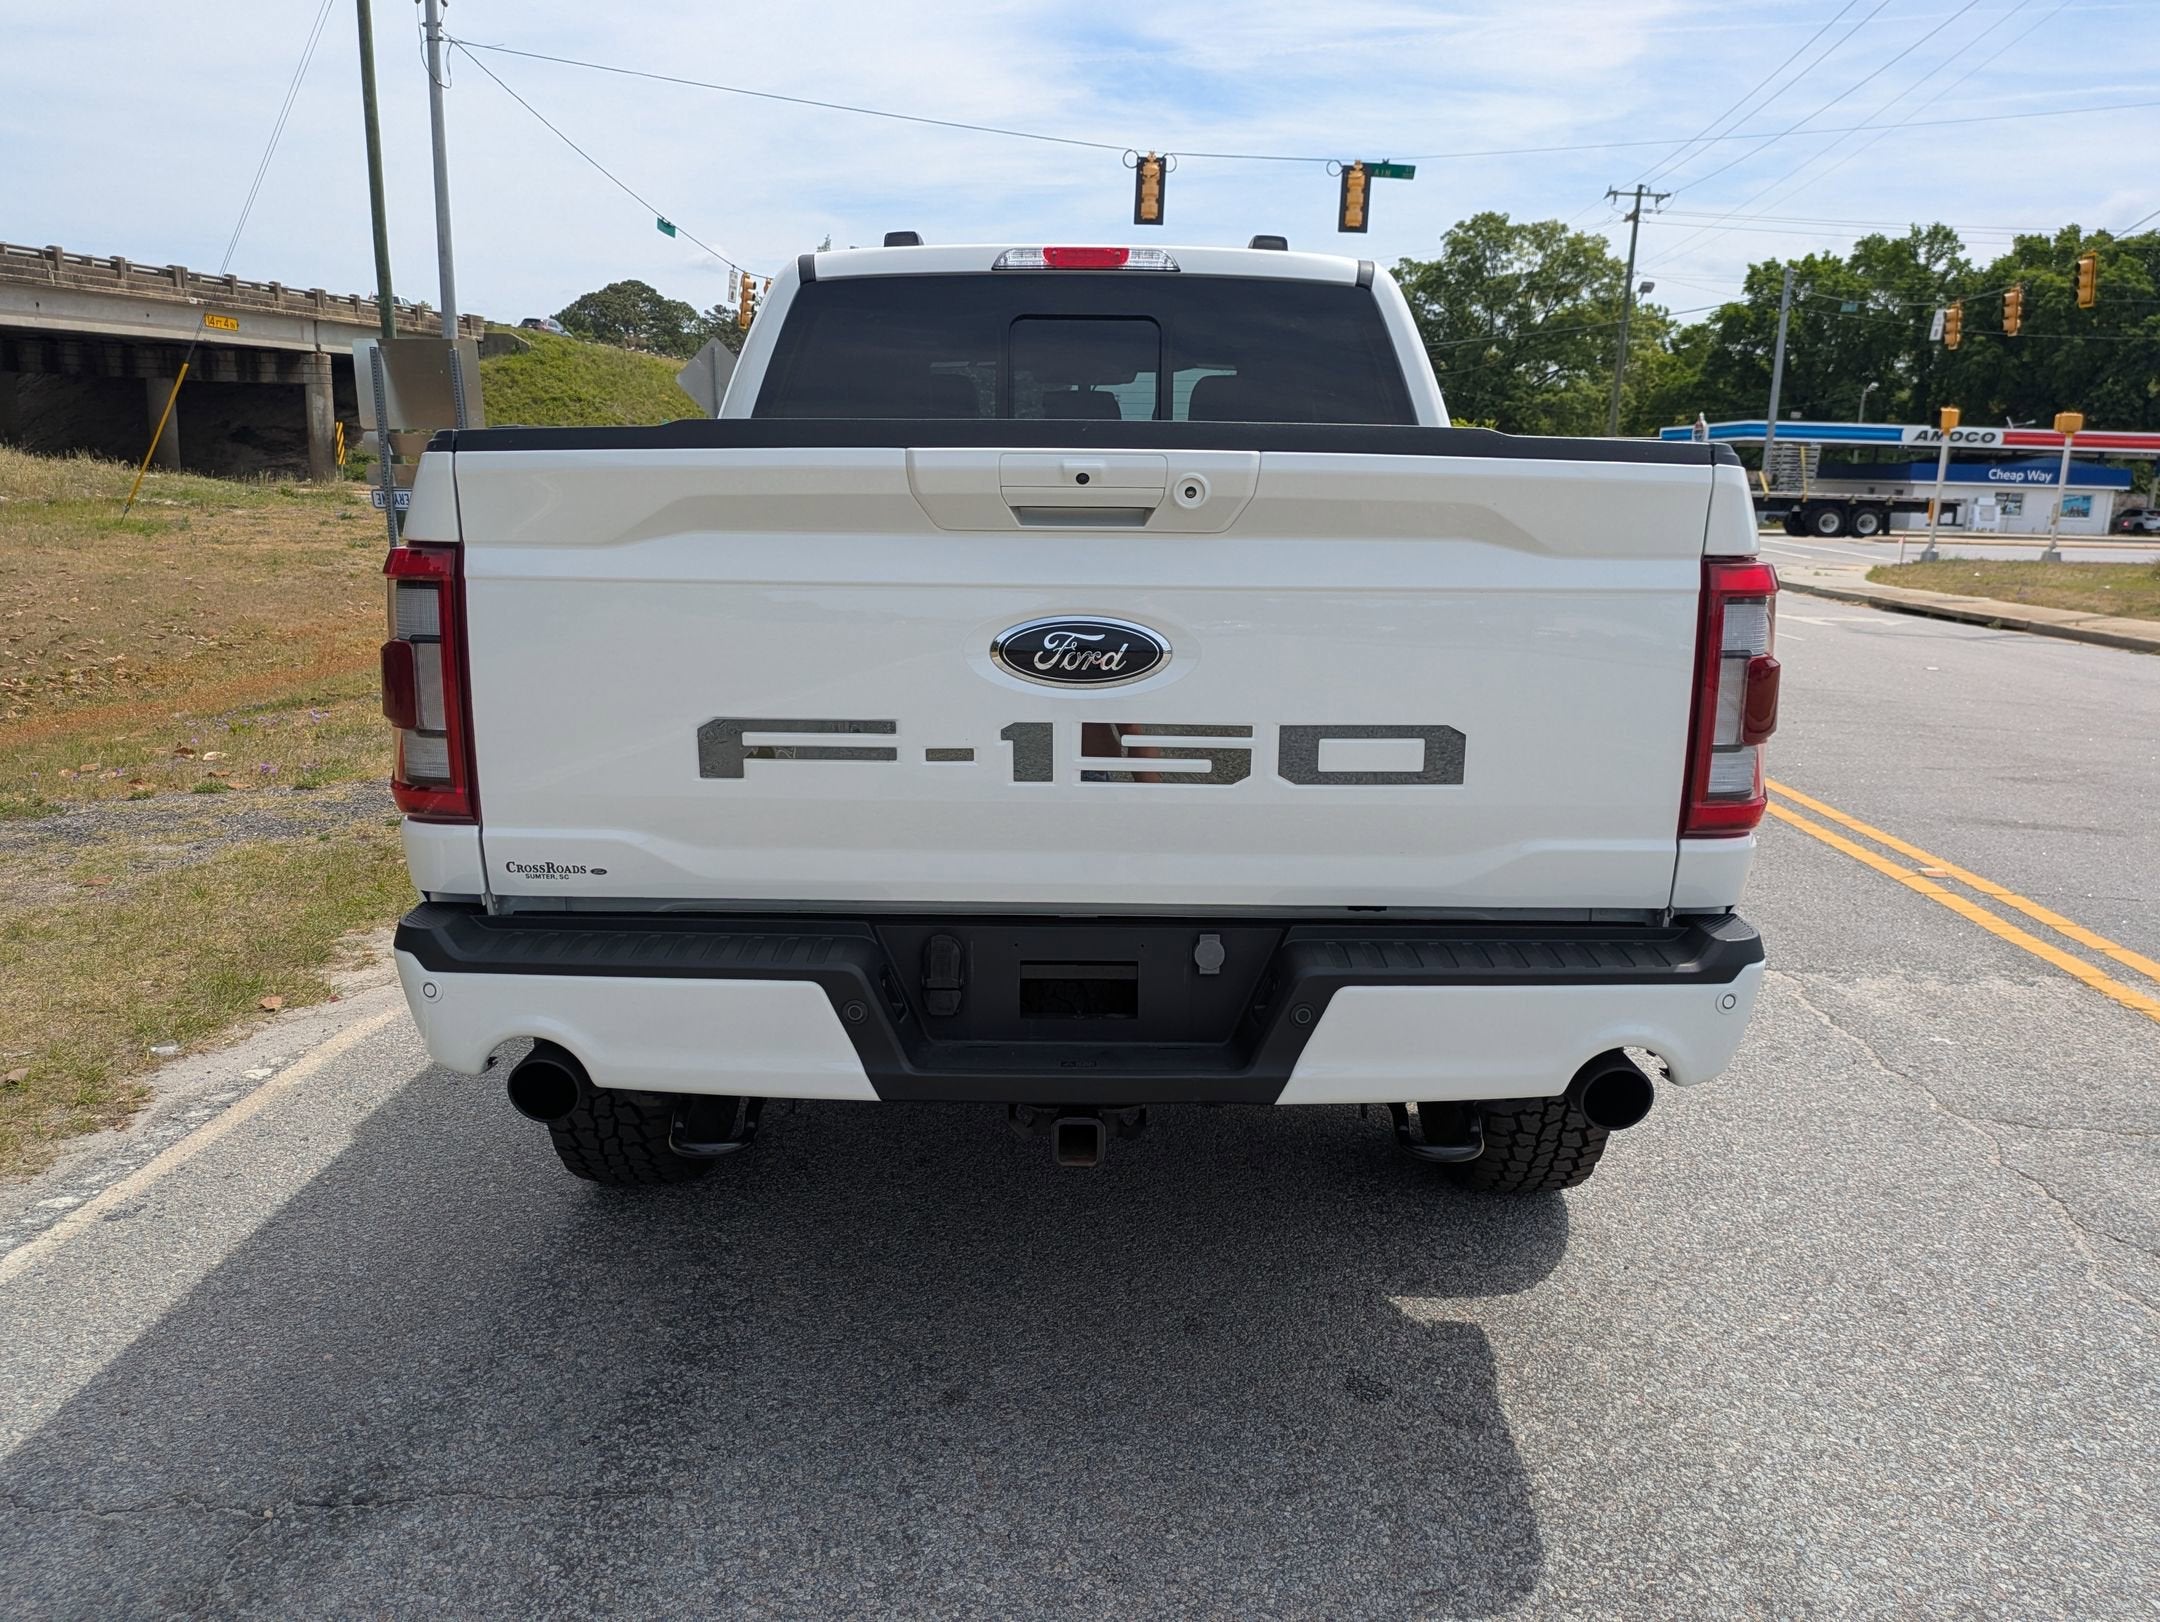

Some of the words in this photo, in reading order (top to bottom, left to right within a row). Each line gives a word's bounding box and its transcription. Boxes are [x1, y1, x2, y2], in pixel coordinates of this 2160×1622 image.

[207, 315, 215, 327] 14
[1988, 468, 2024, 482] Cheap
[2027, 470, 2053, 483] Way
[1033, 631, 1129, 671] Ford
[697, 718, 1467, 786] F-150
